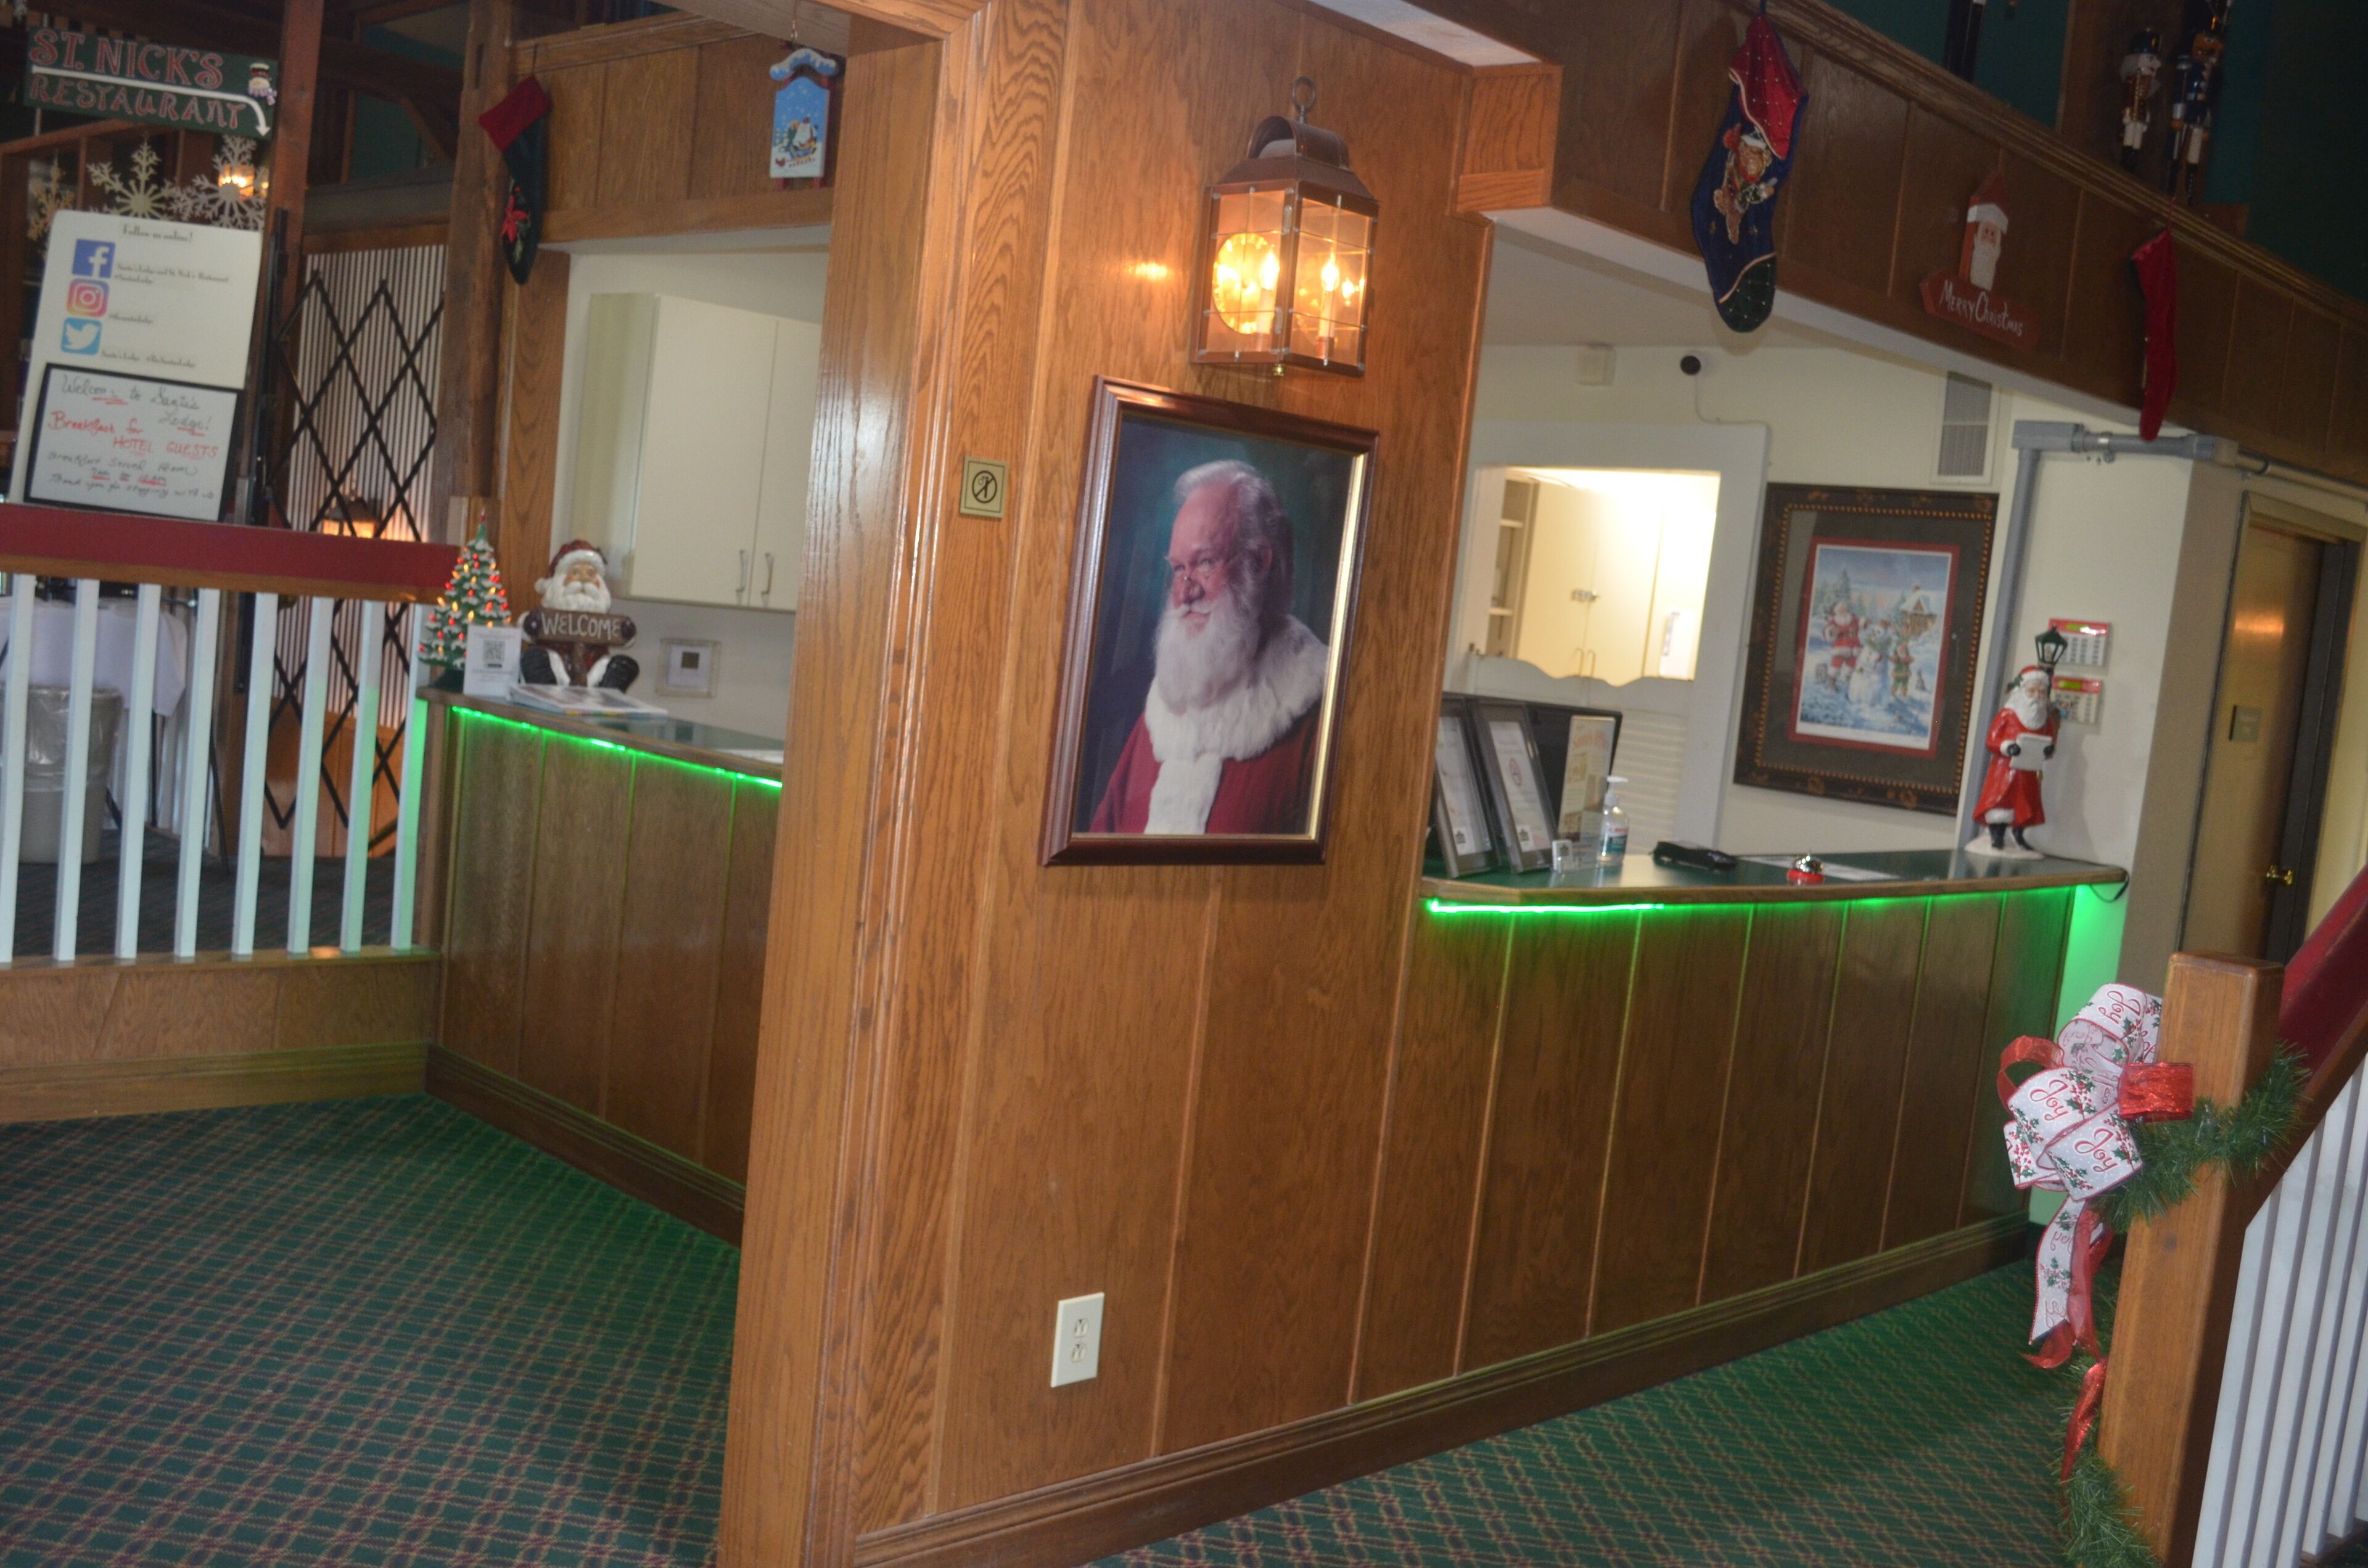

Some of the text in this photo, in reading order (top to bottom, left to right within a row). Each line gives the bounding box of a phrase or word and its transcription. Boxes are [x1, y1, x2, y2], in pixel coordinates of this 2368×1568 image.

[29, 30, 224, 89] ST. NICK'S
[113, 437, 154, 454] HOTEL
[541, 612, 622, 641] WELCOME
[2029, 1078, 2071, 1122] Joy
[2074, 1127, 2119, 1173] Joy
